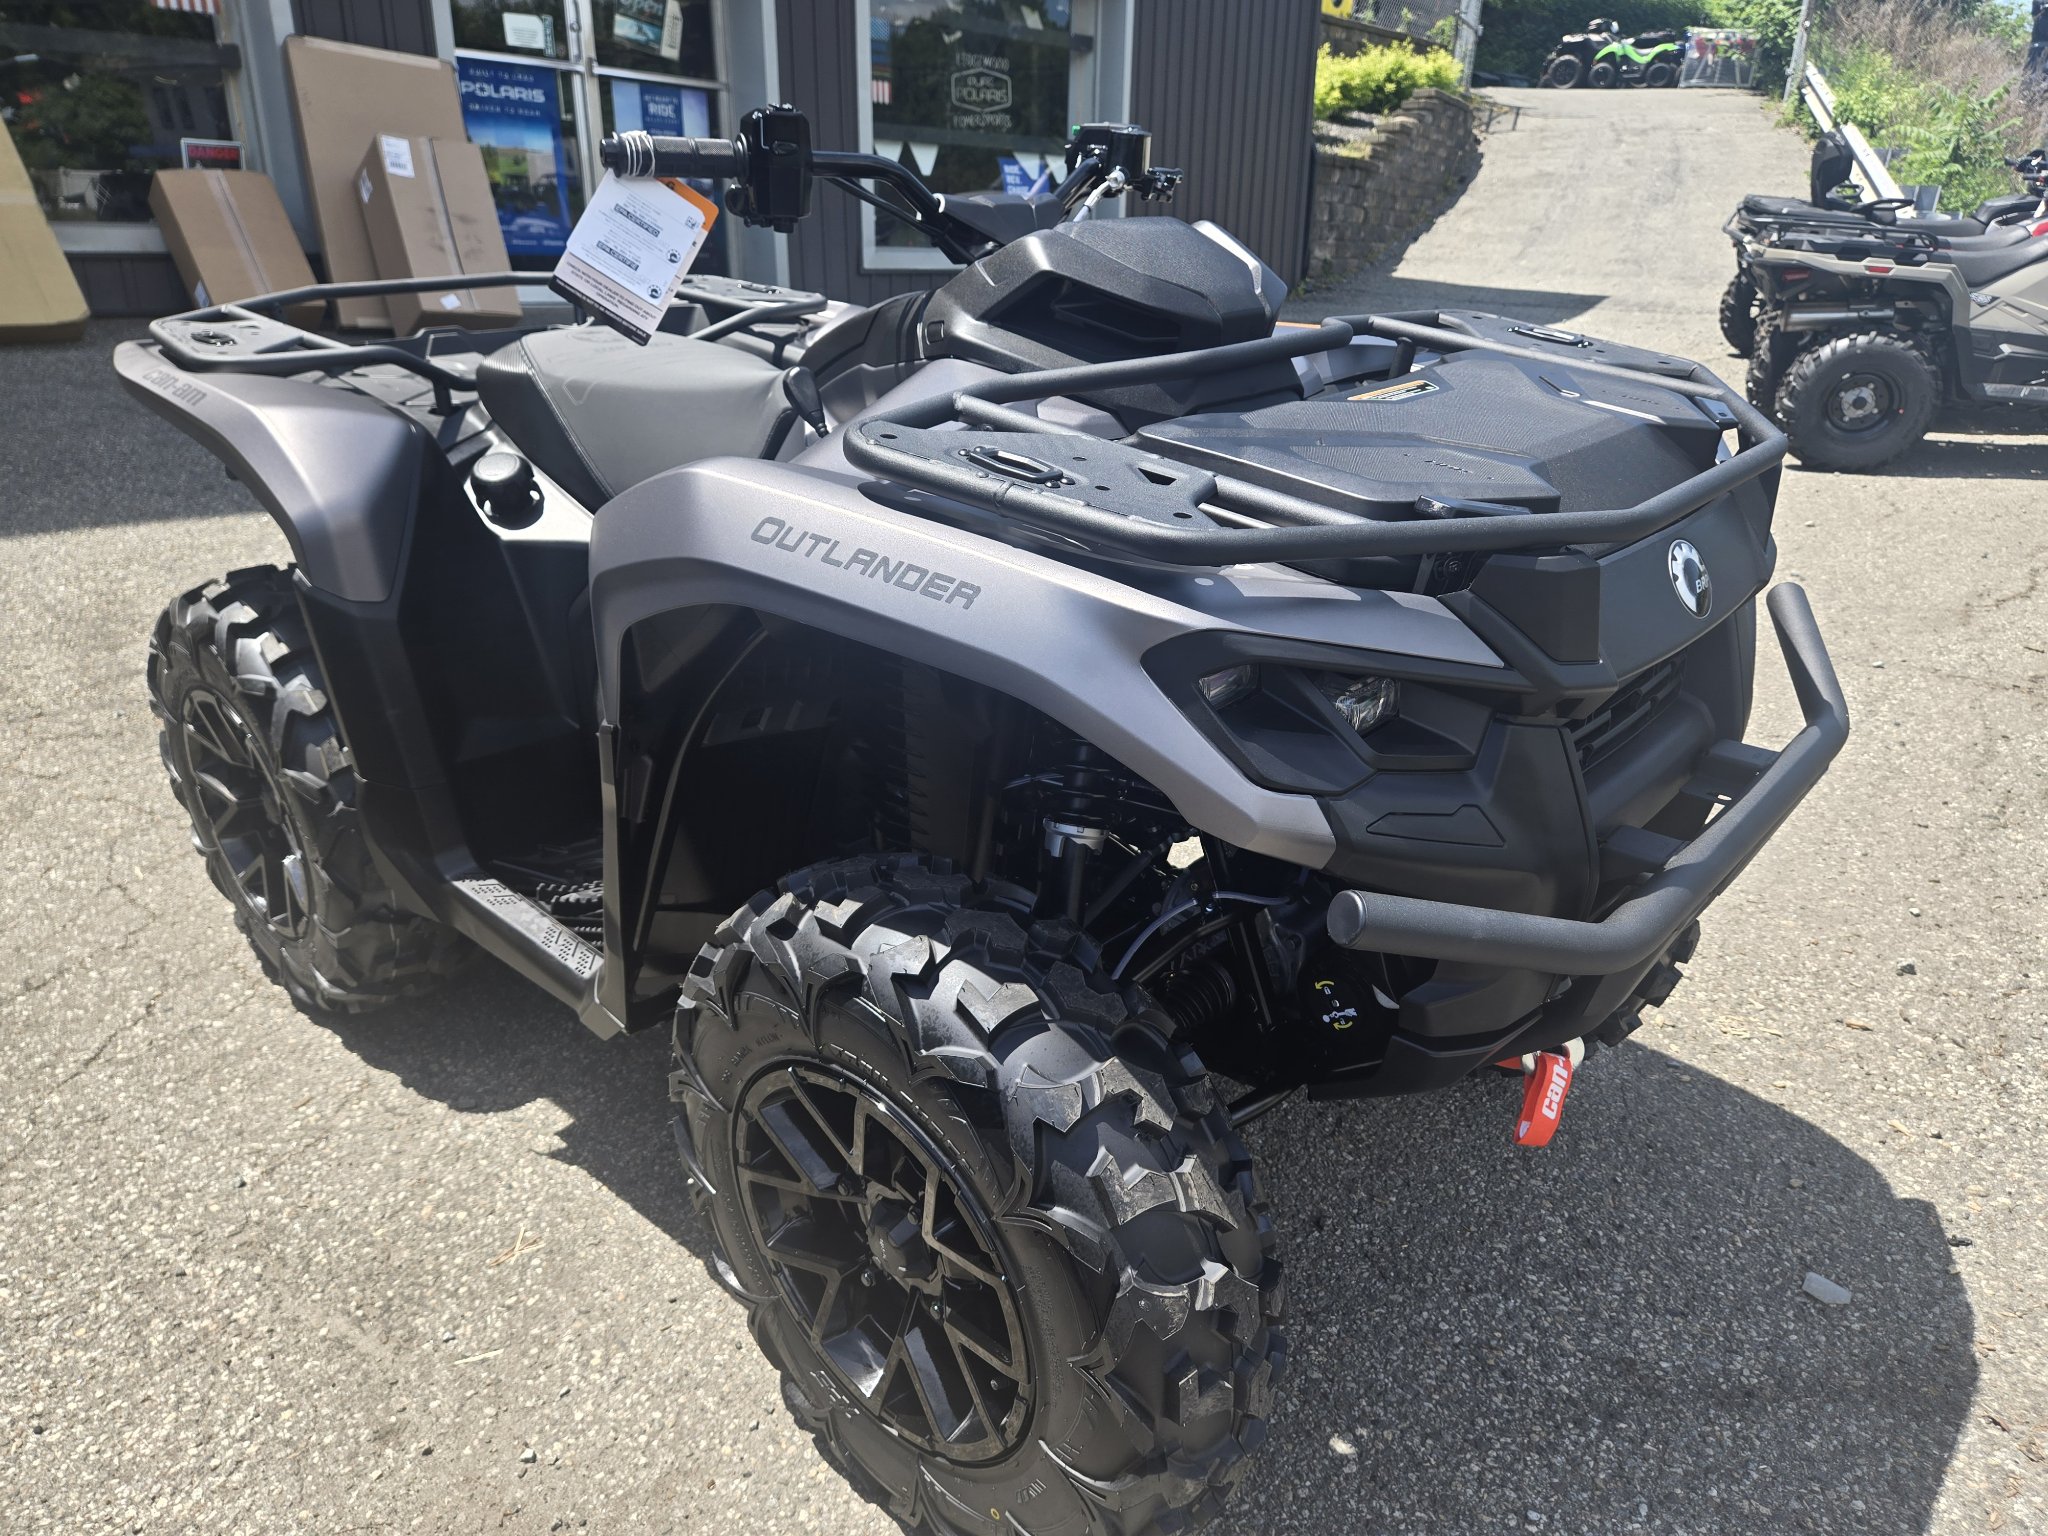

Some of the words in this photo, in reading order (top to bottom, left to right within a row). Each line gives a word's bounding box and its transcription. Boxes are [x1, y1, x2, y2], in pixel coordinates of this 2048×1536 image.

[461, 80, 546, 103] POLARIS
[956, 87, 1008, 102] POLARIS
[614, 204, 628, 216] EPA
[626, 213, 659, 236] CERTIFIED
[142, 368, 208, 407] can-am
[750, 516, 982, 610] OUTLANDER
